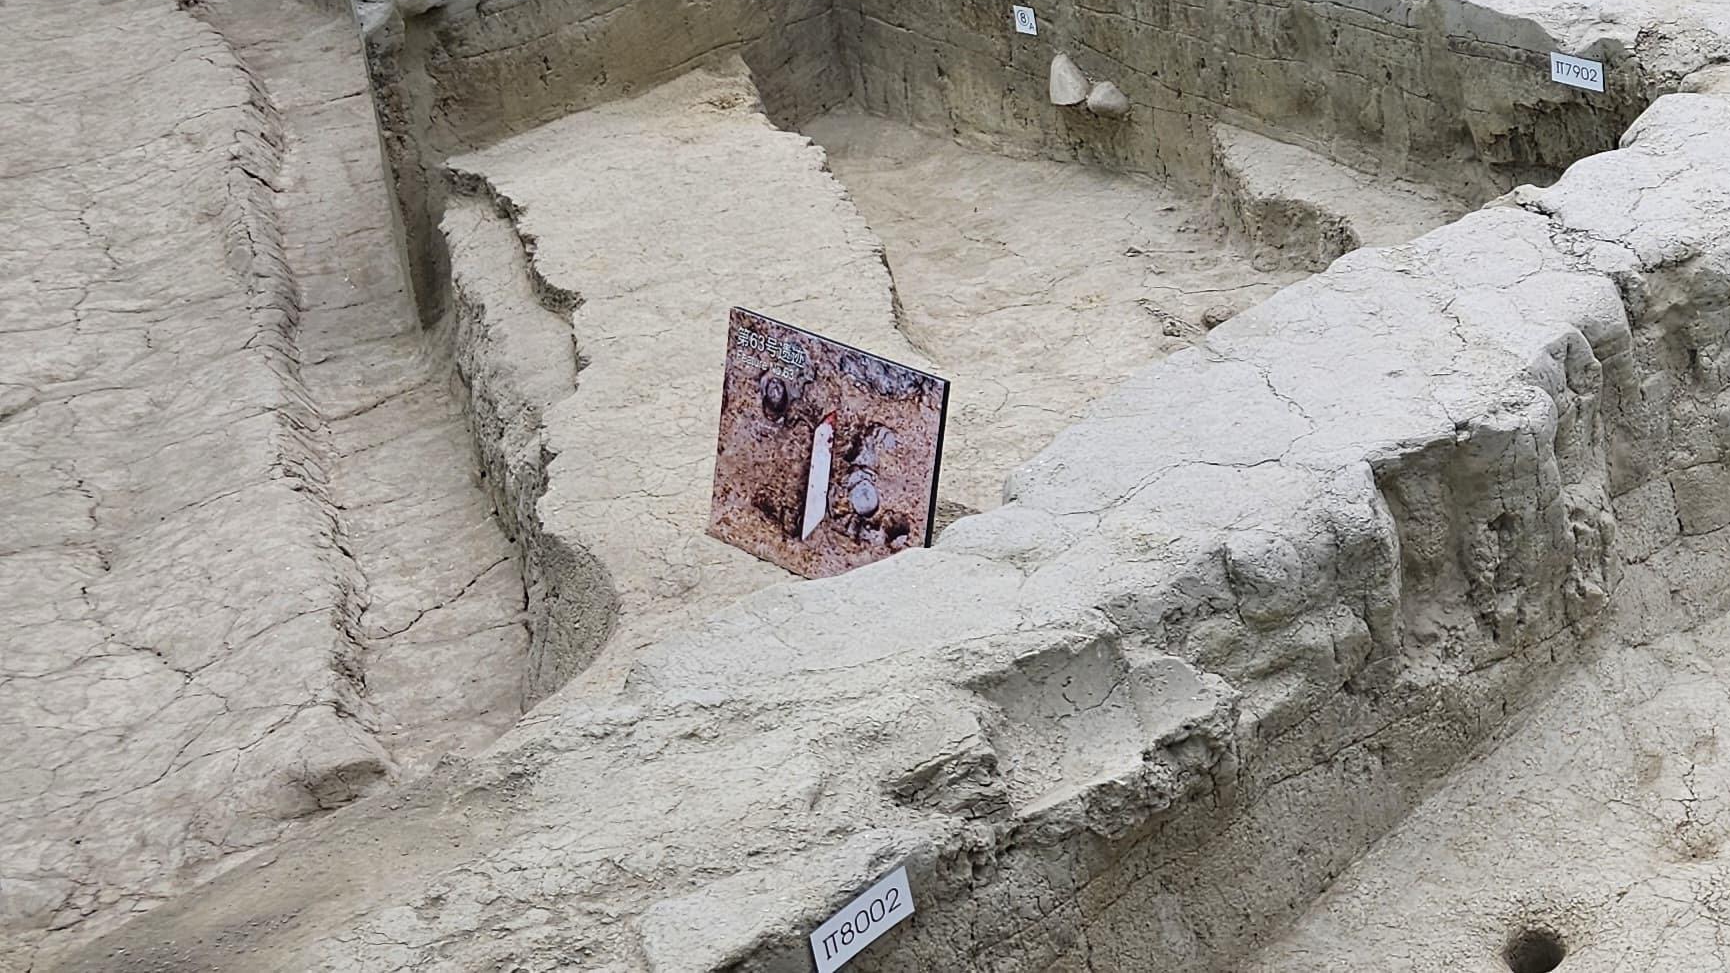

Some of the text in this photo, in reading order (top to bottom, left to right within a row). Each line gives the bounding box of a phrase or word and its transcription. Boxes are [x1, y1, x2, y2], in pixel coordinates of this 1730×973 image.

[1555, 60, 1598, 83] IT7902
[736, 326, 805, 369] 第63号遗迹
[736, 349, 769, 371] Feature
[821, 887, 902, 961] IT8002
